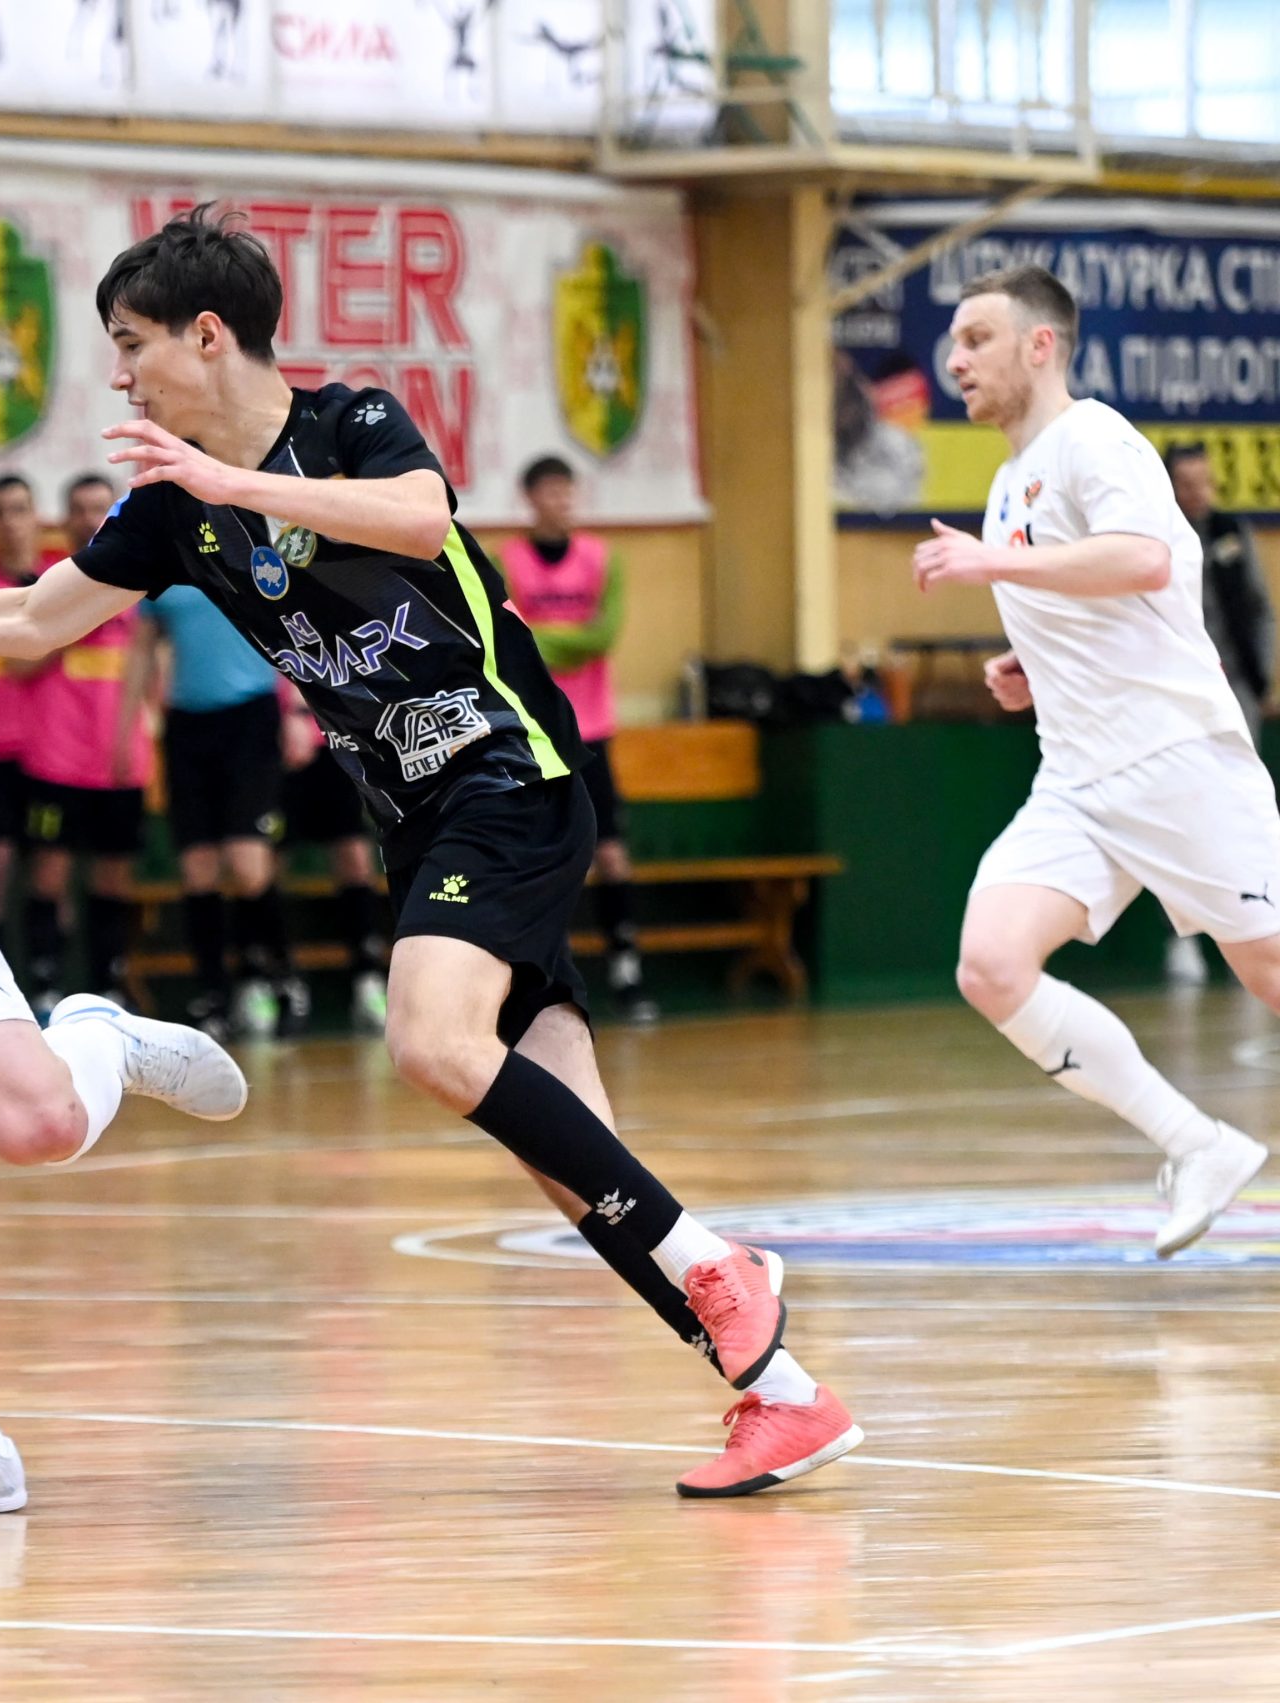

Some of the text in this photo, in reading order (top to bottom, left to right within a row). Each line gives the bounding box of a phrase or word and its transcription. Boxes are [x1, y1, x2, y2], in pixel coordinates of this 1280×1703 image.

[131, 198, 468, 350] TER
[198, 544, 221, 554] KEL
[429, 892, 469, 904] KELME
